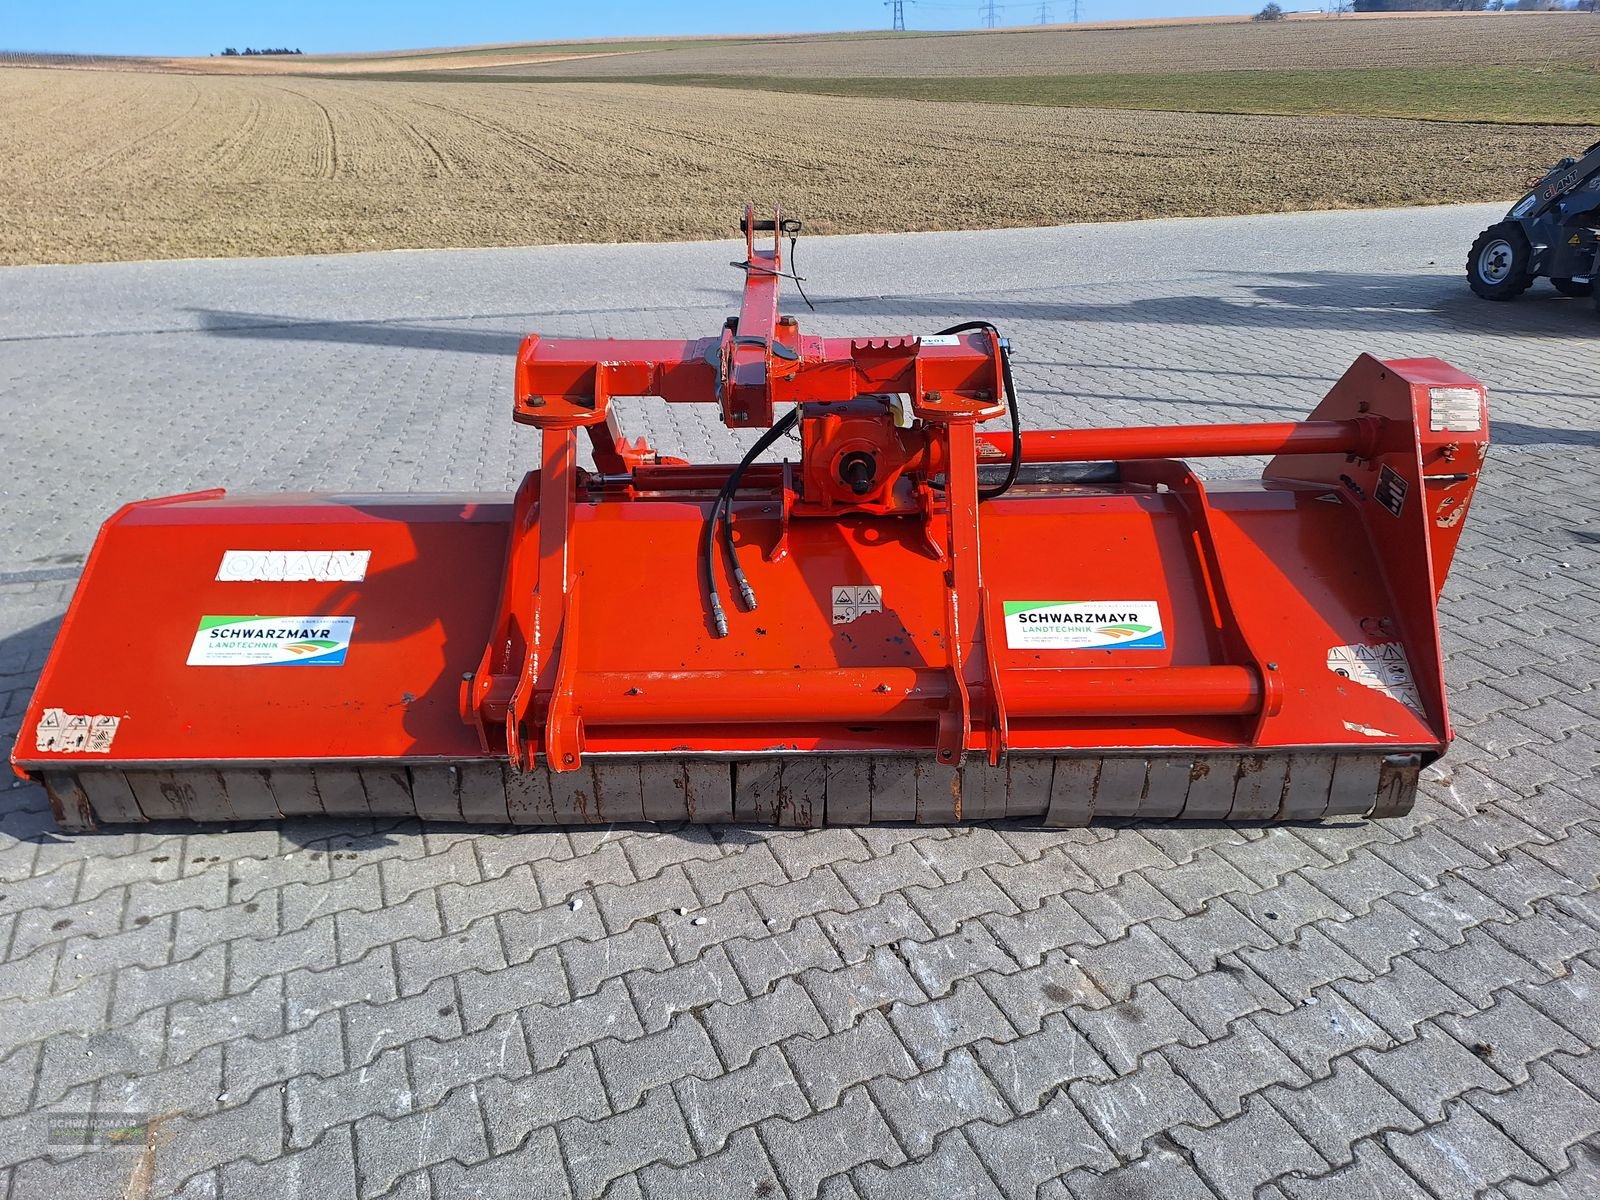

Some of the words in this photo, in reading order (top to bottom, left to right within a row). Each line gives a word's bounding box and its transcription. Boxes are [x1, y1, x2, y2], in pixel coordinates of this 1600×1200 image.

[1018, 613, 1138, 623] SCHWARZMAYR
[210, 629, 330, 639] SCHWARZMAYR
[208, 641, 279, 649] LANDTECHNIK
